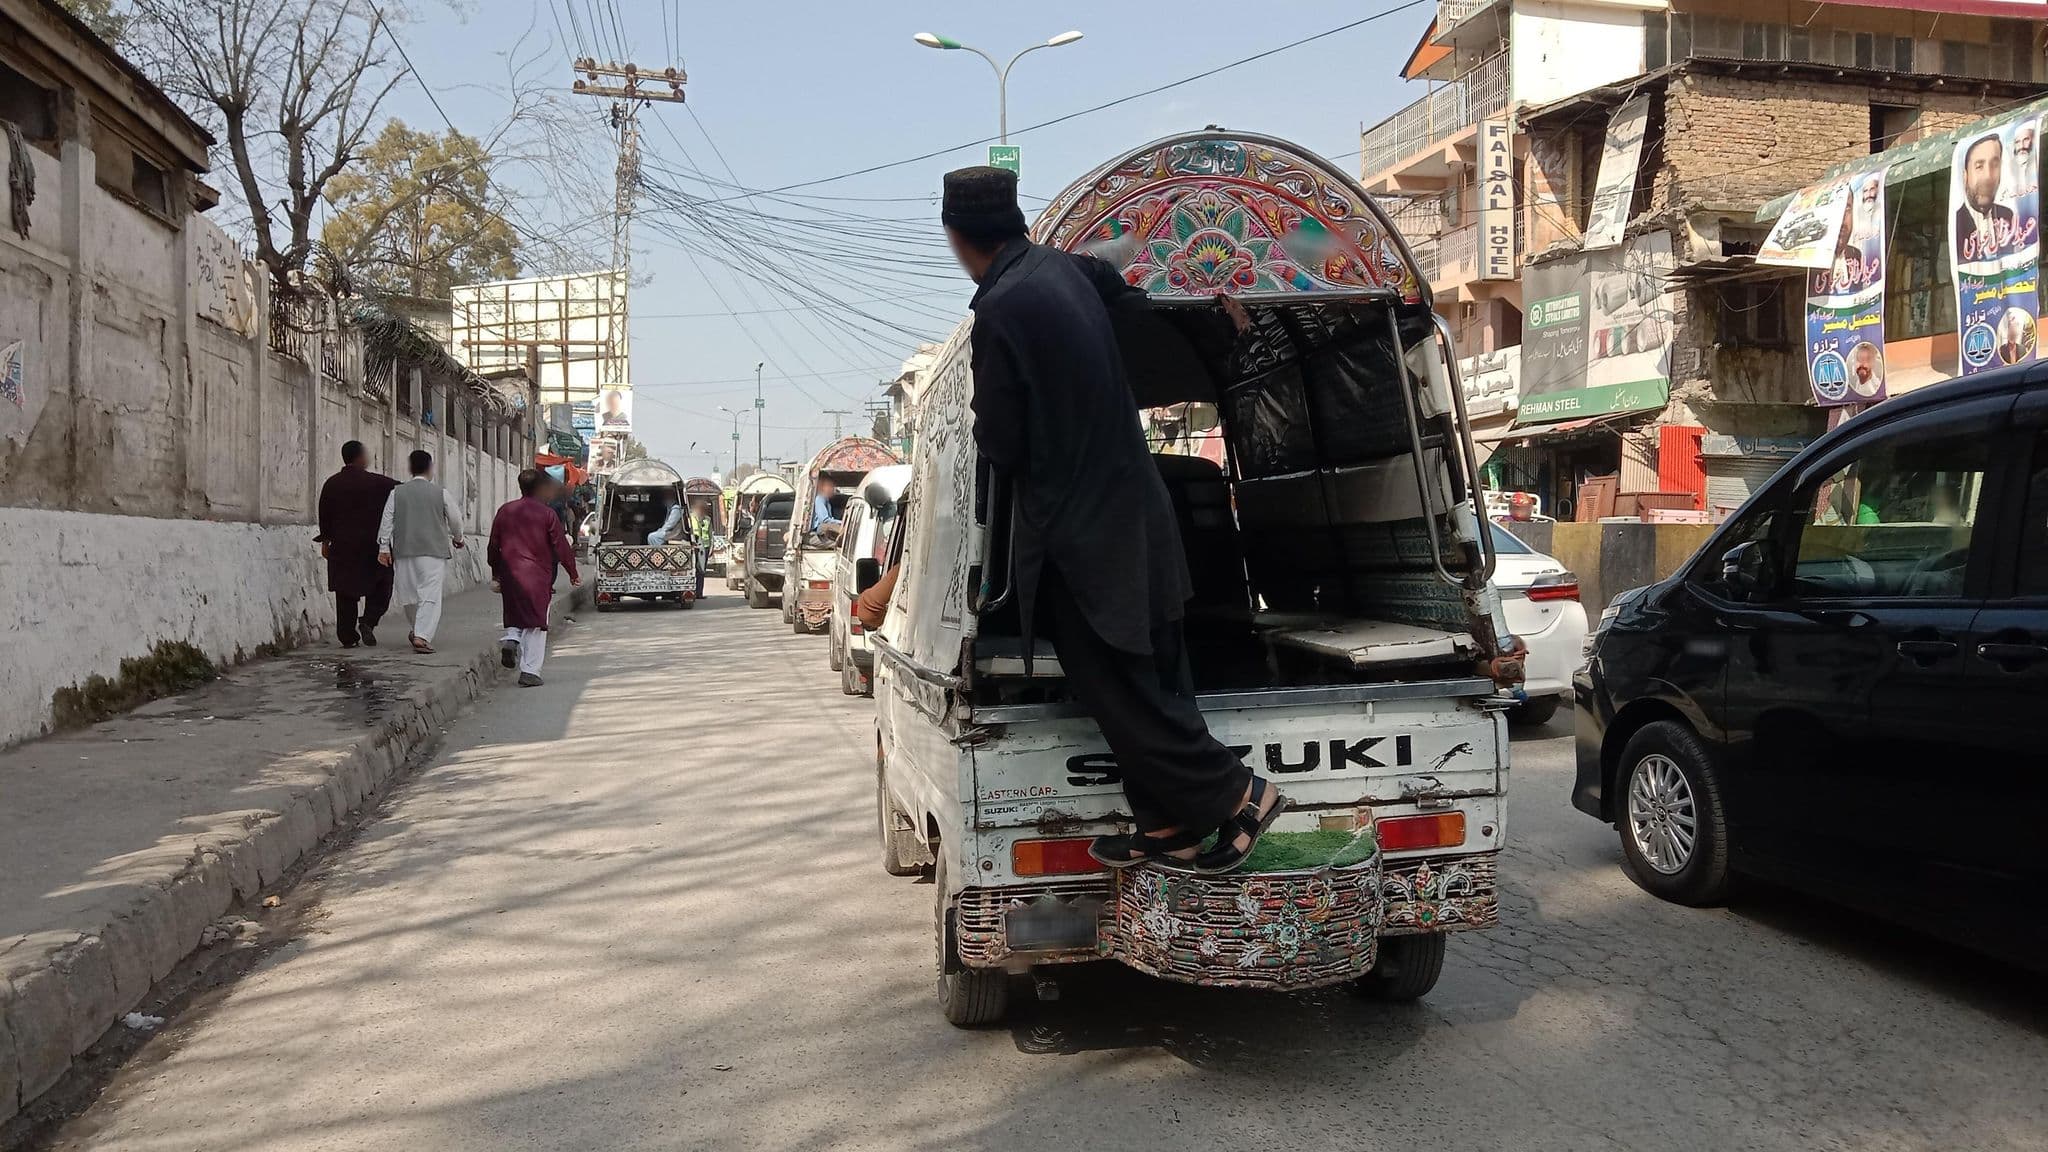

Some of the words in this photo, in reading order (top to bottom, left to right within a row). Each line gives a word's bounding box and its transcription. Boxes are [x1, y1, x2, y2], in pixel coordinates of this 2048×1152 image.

[1489, 125, 1507, 210] FAISAL
[1490, 225, 1508, 275] HOTEL
[1965, 310, 1986, 326] ترازو
[1813, 338, 1839, 353] ترازو
[1520, 399, 1554, 416] REHMAN
[1555, 397, 1581, 412] STEEL
[1066, 734, 1413, 786] SUKI
